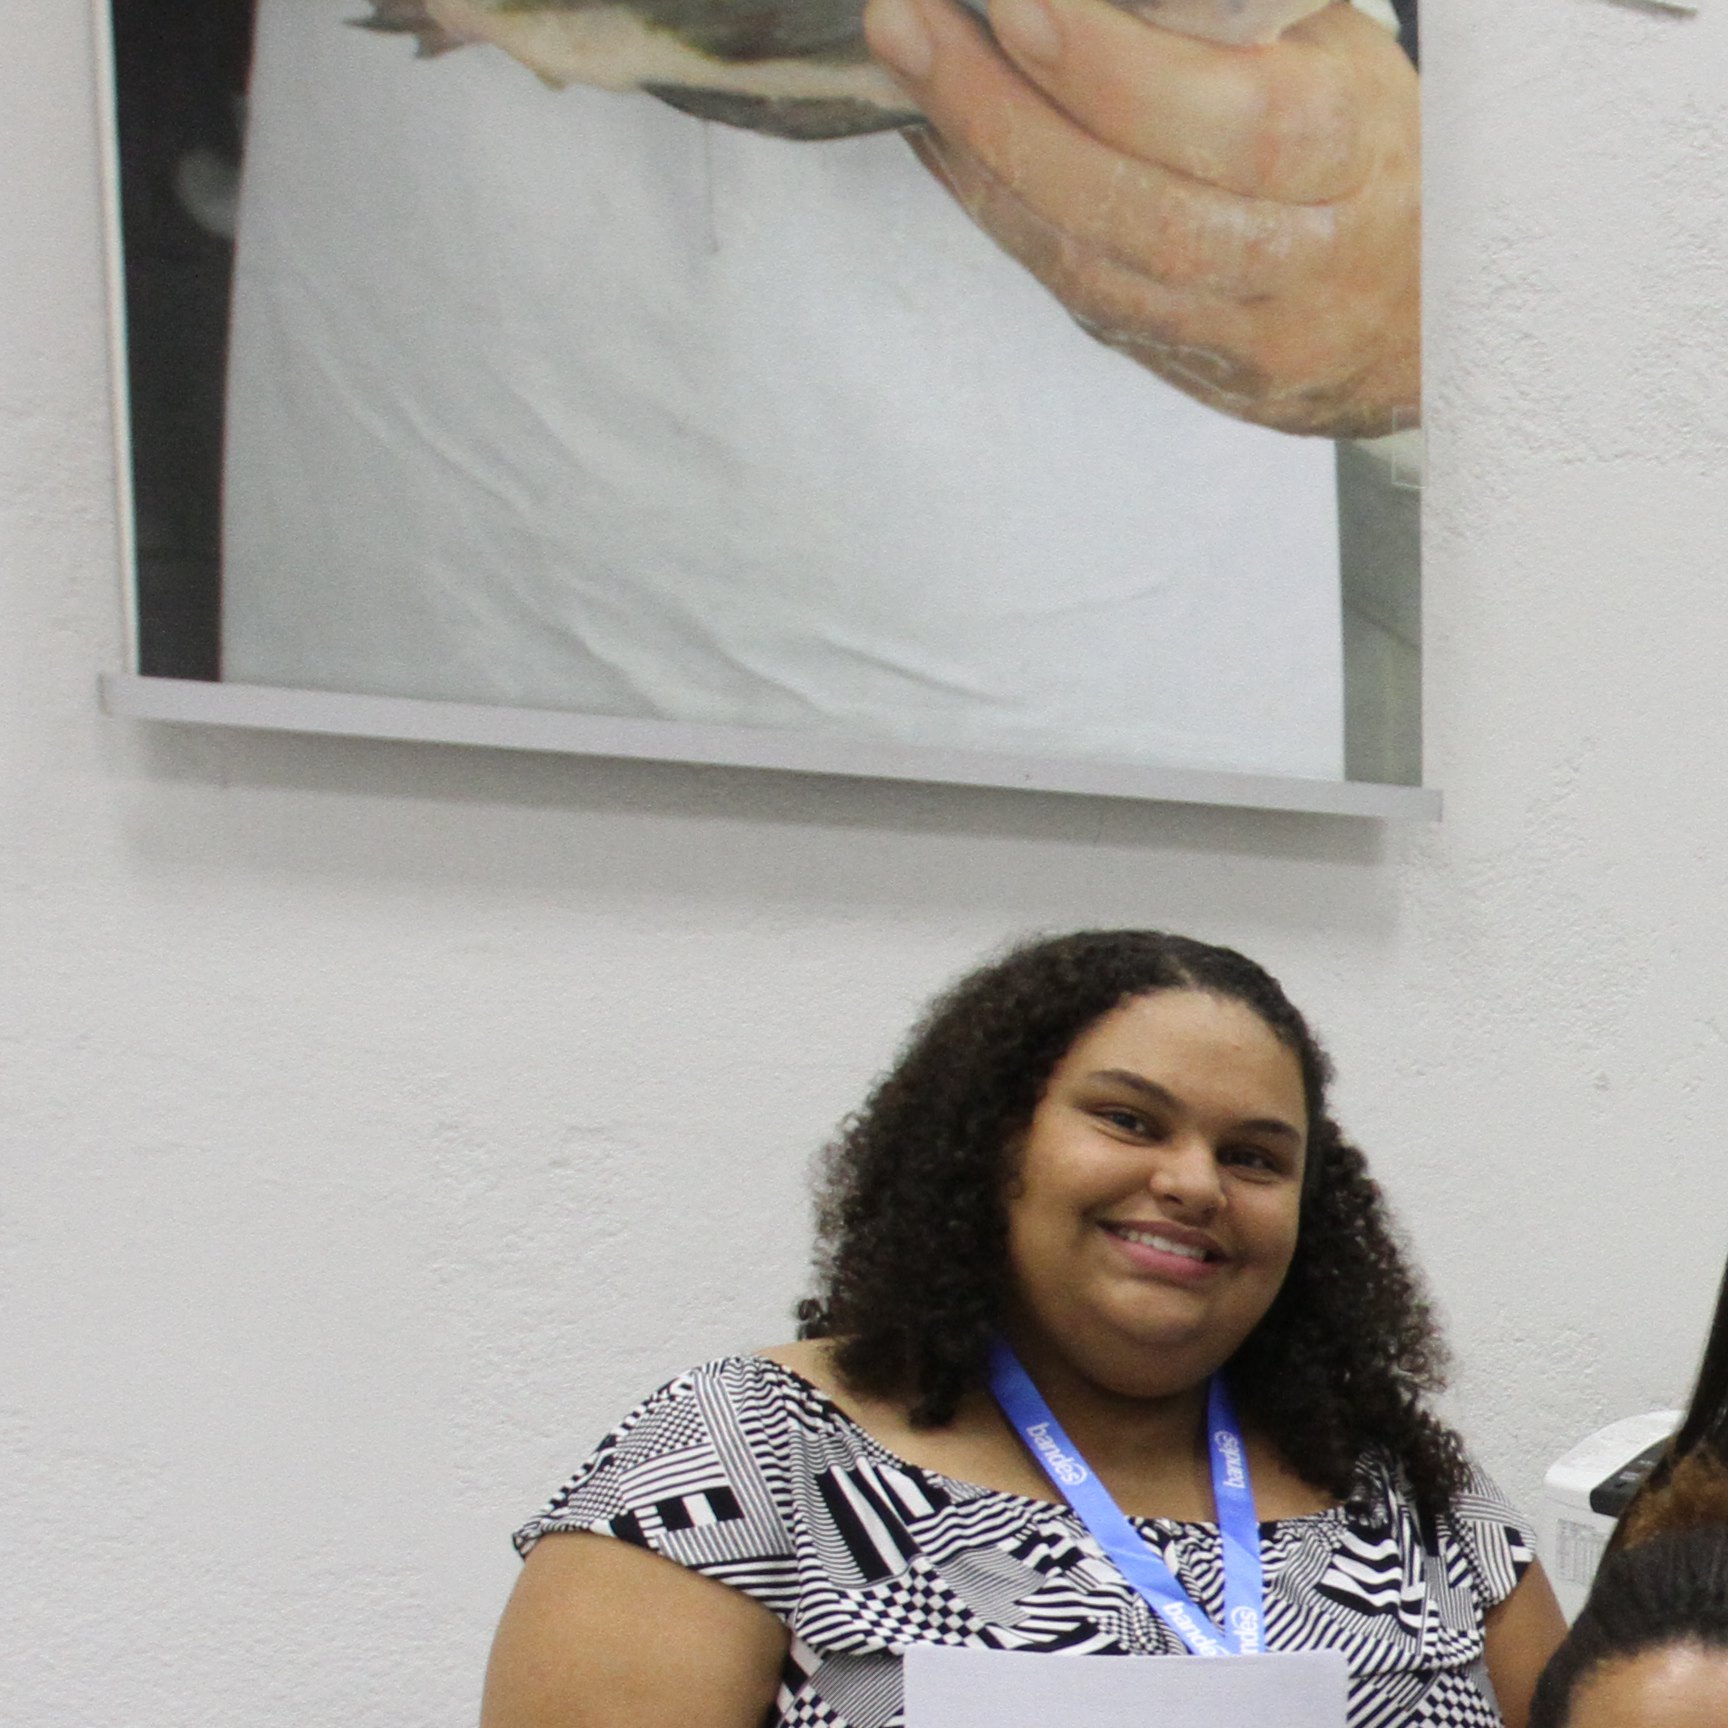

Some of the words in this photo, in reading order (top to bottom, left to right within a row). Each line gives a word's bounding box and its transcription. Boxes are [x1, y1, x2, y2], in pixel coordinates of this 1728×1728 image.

[1026, 1422, 1087, 1485] bandes
[1214, 1430, 1246, 1488] bandes
[1163, 1601, 1225, 1656] bande
